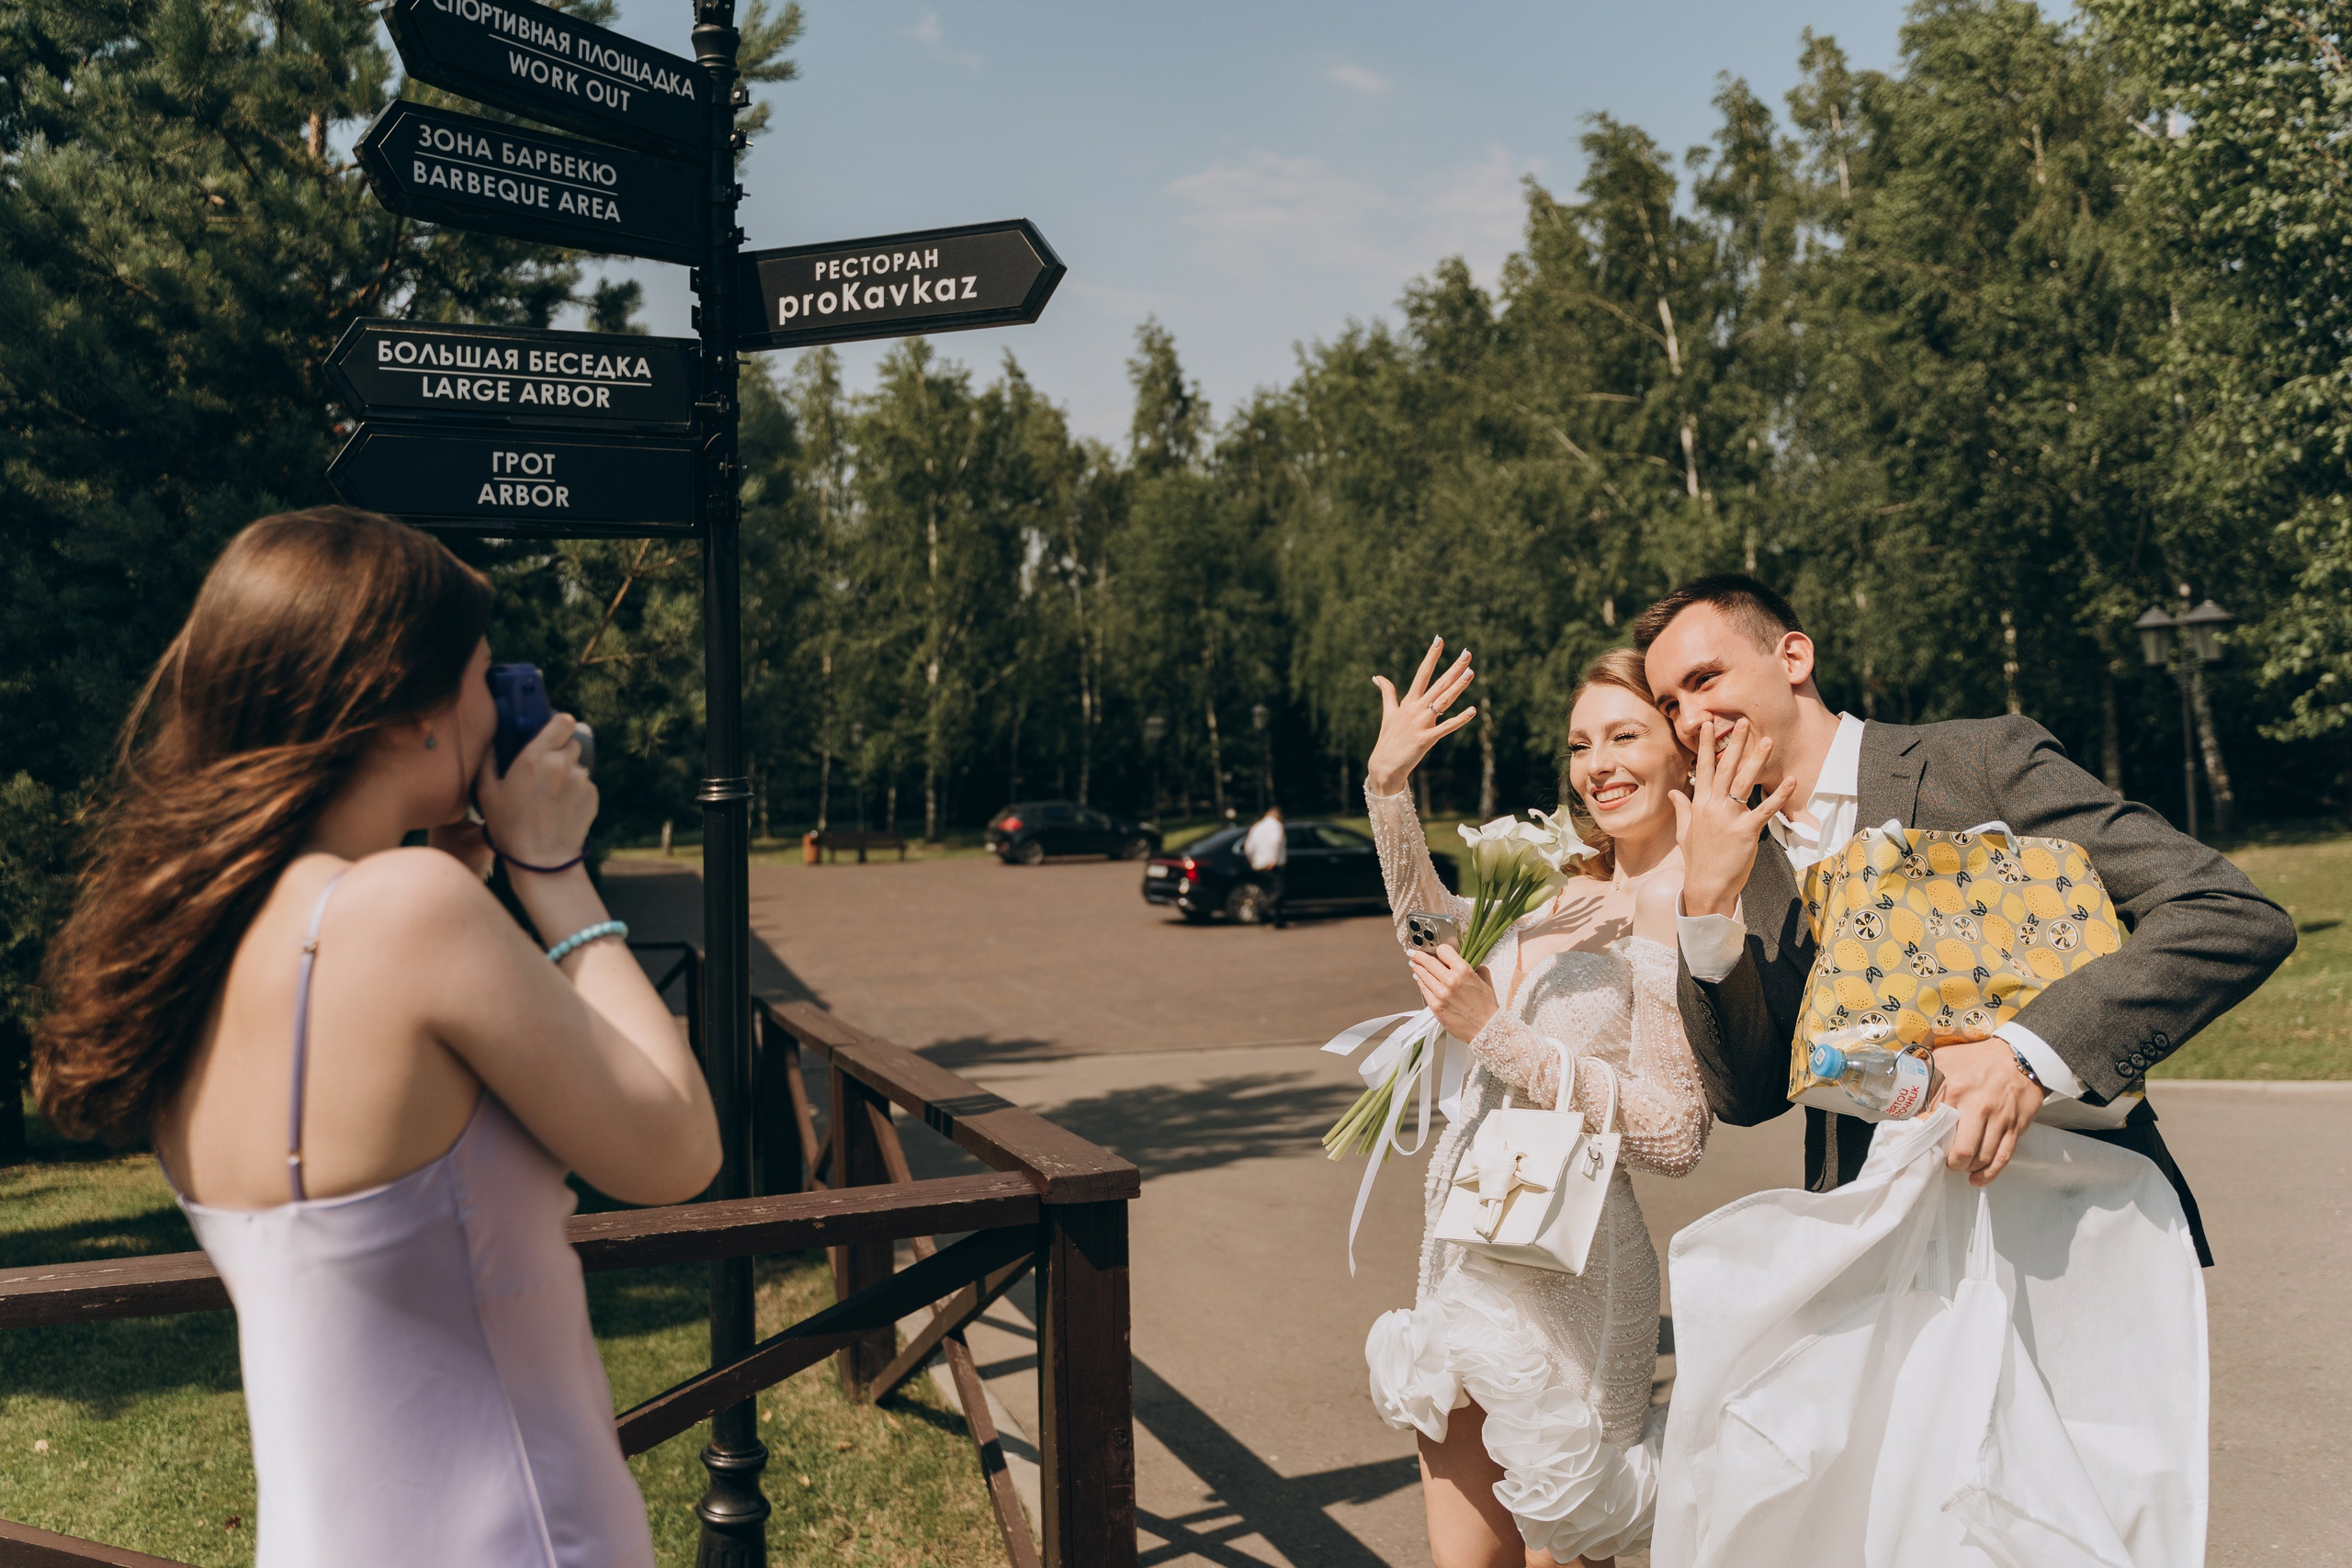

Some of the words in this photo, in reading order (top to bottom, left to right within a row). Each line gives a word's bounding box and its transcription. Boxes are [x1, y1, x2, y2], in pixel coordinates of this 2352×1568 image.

[509, 51, 579, 96] WORK
[586, 80, 630, 112] OUT
[579, 39, 695, 100] ПЛОЩАДКА
[418, 125, 492, 161] ЗОНА
[503, 143, 617, 186] БАРБЕКЮ
[413, 161, 549, 209] BARBEQUE
[559, 192, 621, 223] AREA
[815, 249, 939, 281] РЕСТОРАН
[778, 275, 978, 325] proKavkaz
[379, 341, 518, 370] БОЛЬШАЯ
[530, 351, 651, 378] БЕСЕДКА
[423, 377, 510, 402] LARGE
[519, 383, 610, 408] ARBOR
[493, 452, 555, 475] ГРОТ
[478, 484, 569, 507] ARBOR
[1883, 1088, 1909, 1114] ВЯТОЙ
